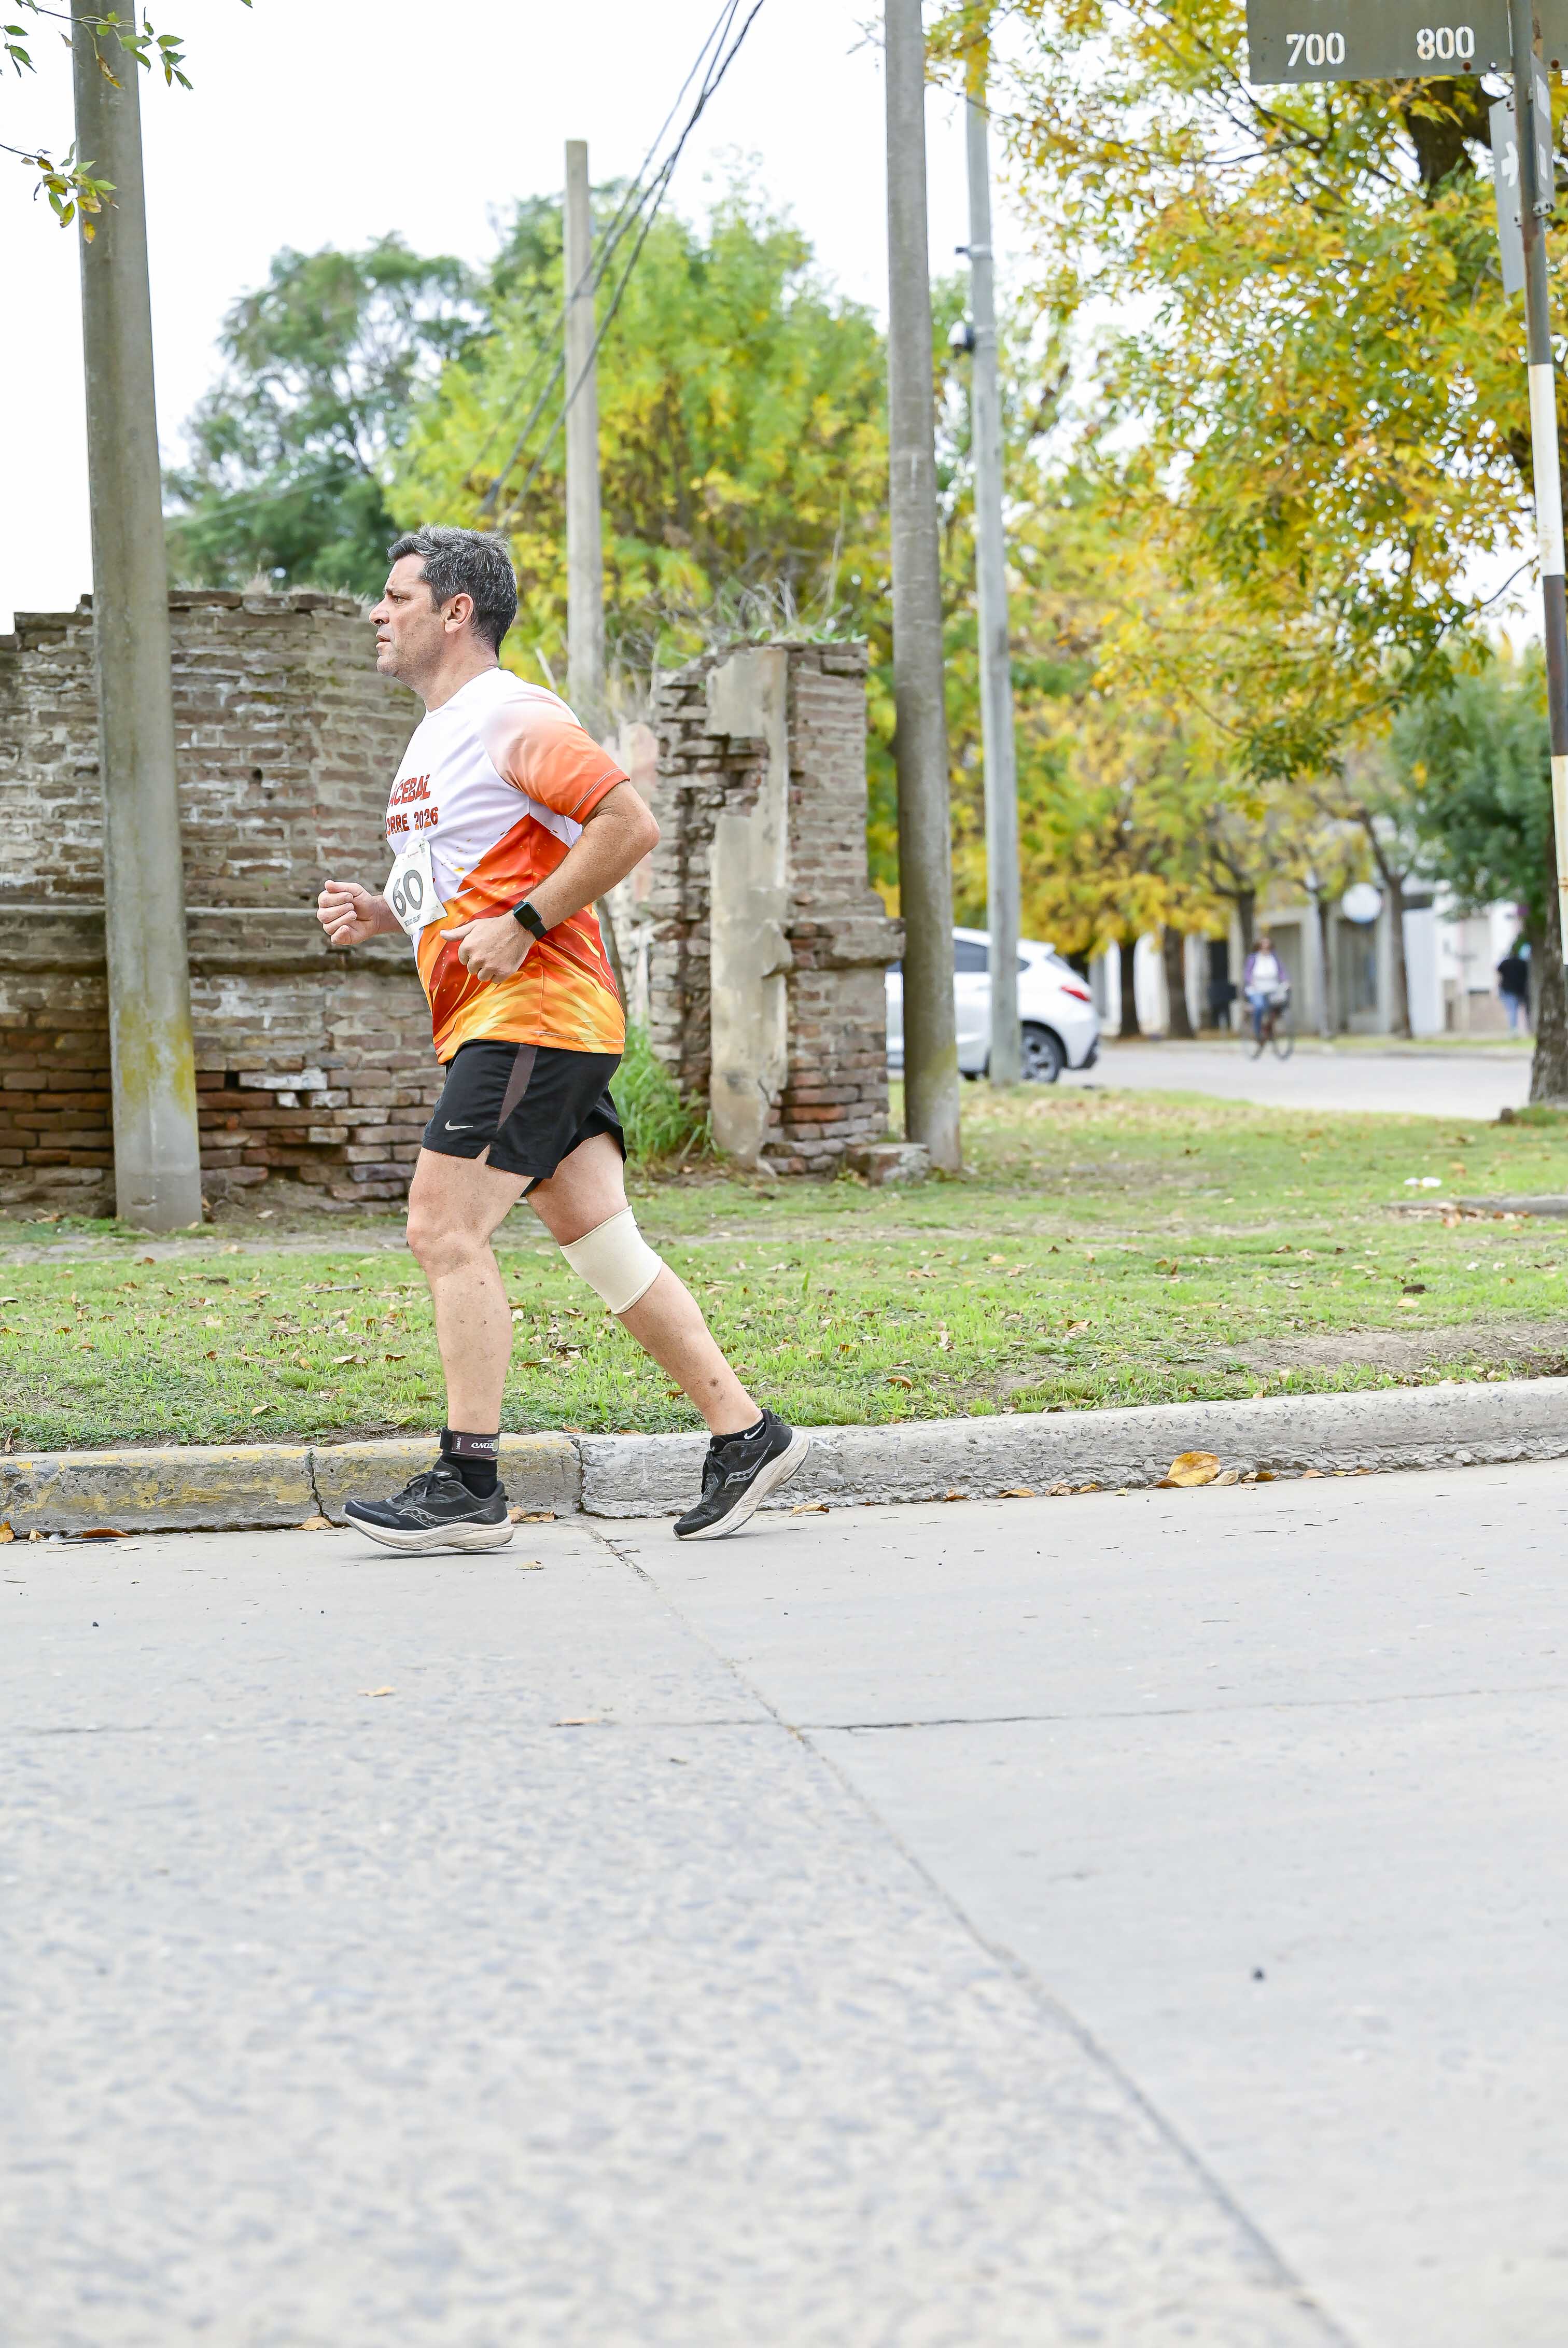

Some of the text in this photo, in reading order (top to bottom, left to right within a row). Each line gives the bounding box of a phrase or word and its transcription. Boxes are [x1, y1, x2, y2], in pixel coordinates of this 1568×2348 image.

[1286, 26, 1475, 66] 700 800
[386, 806, 438, 836] ORRE 2026
[393, 870, 423, 917] 60
